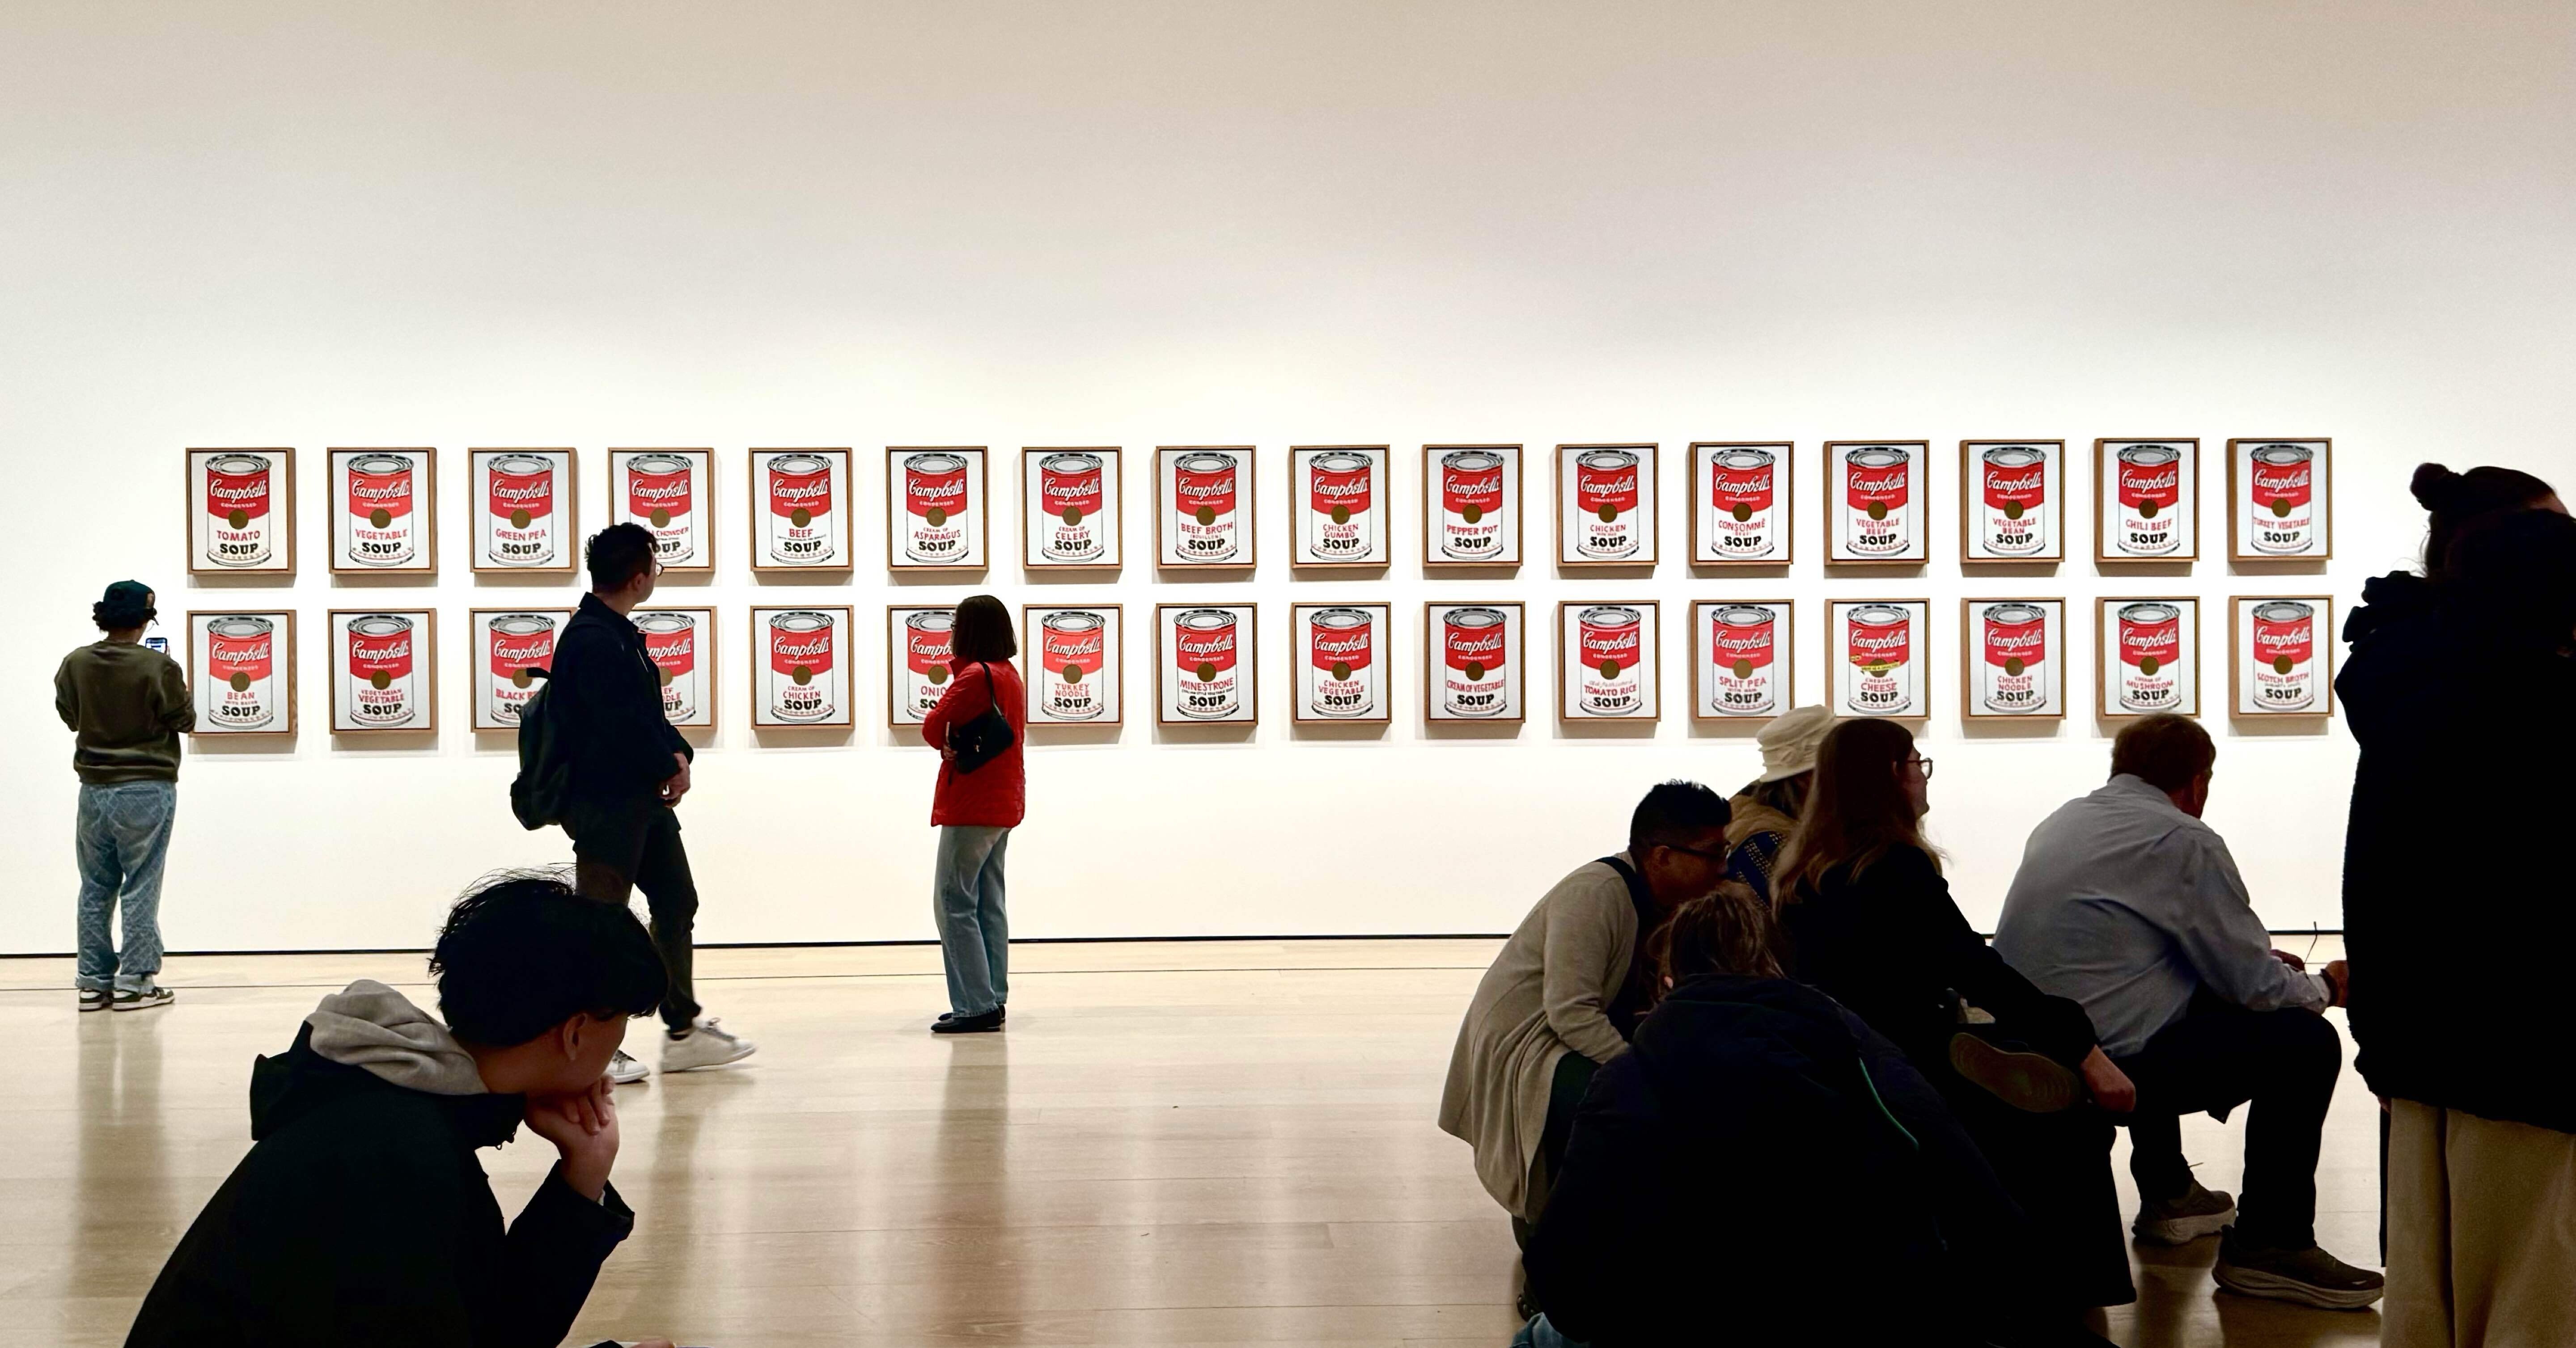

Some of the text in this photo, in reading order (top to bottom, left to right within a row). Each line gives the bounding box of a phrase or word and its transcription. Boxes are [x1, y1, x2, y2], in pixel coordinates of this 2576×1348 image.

[1181, 522, 1233, 534] BEEF BROTH
[1856, 517, 1899, 528] VEGETABLE
[1993, 518, 2036, 528] VEGETABLE
[2126, 519, 2172, 531] CHILI BEEF
[216, 530, 260, 541] TOMATO
[356, 529, 407, 540] VEGETABLE
[496, 528, 546, 541] GREEN PEA
[657, 527, 688, 537] CHOWDER
[789, 528, 813, 537] BEEF
[914, 529, 961, 540] ASPARAGUS
[1447, 525, 1497, 535] PEPPER POT
[1056, 531, 1090, 541] CELERY
[1590, 536, 1627, 547] SOUP
[1724, 536, 1761, 547] SOUP
[1860, 534, 1896, 545] SOUP
[1996, 533, 2033, 544] SOUP
[2131, 532, 2167, 544] SOUP
[2264, 531, 2300, 543] SOUP
[362, 542, 401, 554] SOUP
[655, 541, 680, 553] OUP
[784, 541, 821, 553] SOUP
[919, 540, 955, 551] SOUP
[1055, 539, 1092, 551] SOUP
[1188, 538, 1225, 550] SOUP
[1323, 538, 1359, 549] SOUP
[1455, 537, 1491, 548] SOUP
[220, 543, 258, 554] SOUP
[502, 543, 541, 554] SOUP
[911, 636, 952, 659] Campb
[1719, 676, 1766, 688] SPLIT PEA
[1997, 676, 2032, 685] CHICKEN
[2258, 672, 2309, 684] SCOTCH BROTH
[1180, 678, 1234, 691] MINESTRONE
[1447, 680, 1465, 692] CREAM
[1473, 679, 1504, 692] VEGETABLE
[1584, 683, 1637, 697] TOMATO RICE
[1860, 682, 1897, 692] CHEESE
[1999, 683, 2031, 691] NOODLE
[2126, 680, 2174, 690] MUSHROOM
[496, 688, 525, 701] BLACK
[783, 691, 820, 700] CHICKEN
[921, 686, 946, 696] ONIO
[1318, 686, 1364, 695] VEGETABLE
[1997, 690, 2034, 702] SOUP
[2133, 689, 2169, 700] SOUP
[2266, 688, 2301, 699] SOUP
[358, 693, 404, 703] VEGETABLE
[666, 692, 681, 701] DLE
[1189, 695, 1226, 707] SOUP
[1325, 694, 1361, 705] SOUP
[1457, 693, 1494, 706] SOUP
[1593, 696, 1630, 707] SOUP
[1725, 693, 1762, 704] SOUP
[1860, 692, 1898, 702] SOUP
[504, 702, 522, 714] SO
[665, 700, 682, 711] UP
[784, 699, 822, 710] SOUP
[920, 699, 938, 709] SO
[1054, 697, 1091, 708] SOUP
[222, 706, 260, 717] SOUP
[364, 704, 402, 715] SOUP
